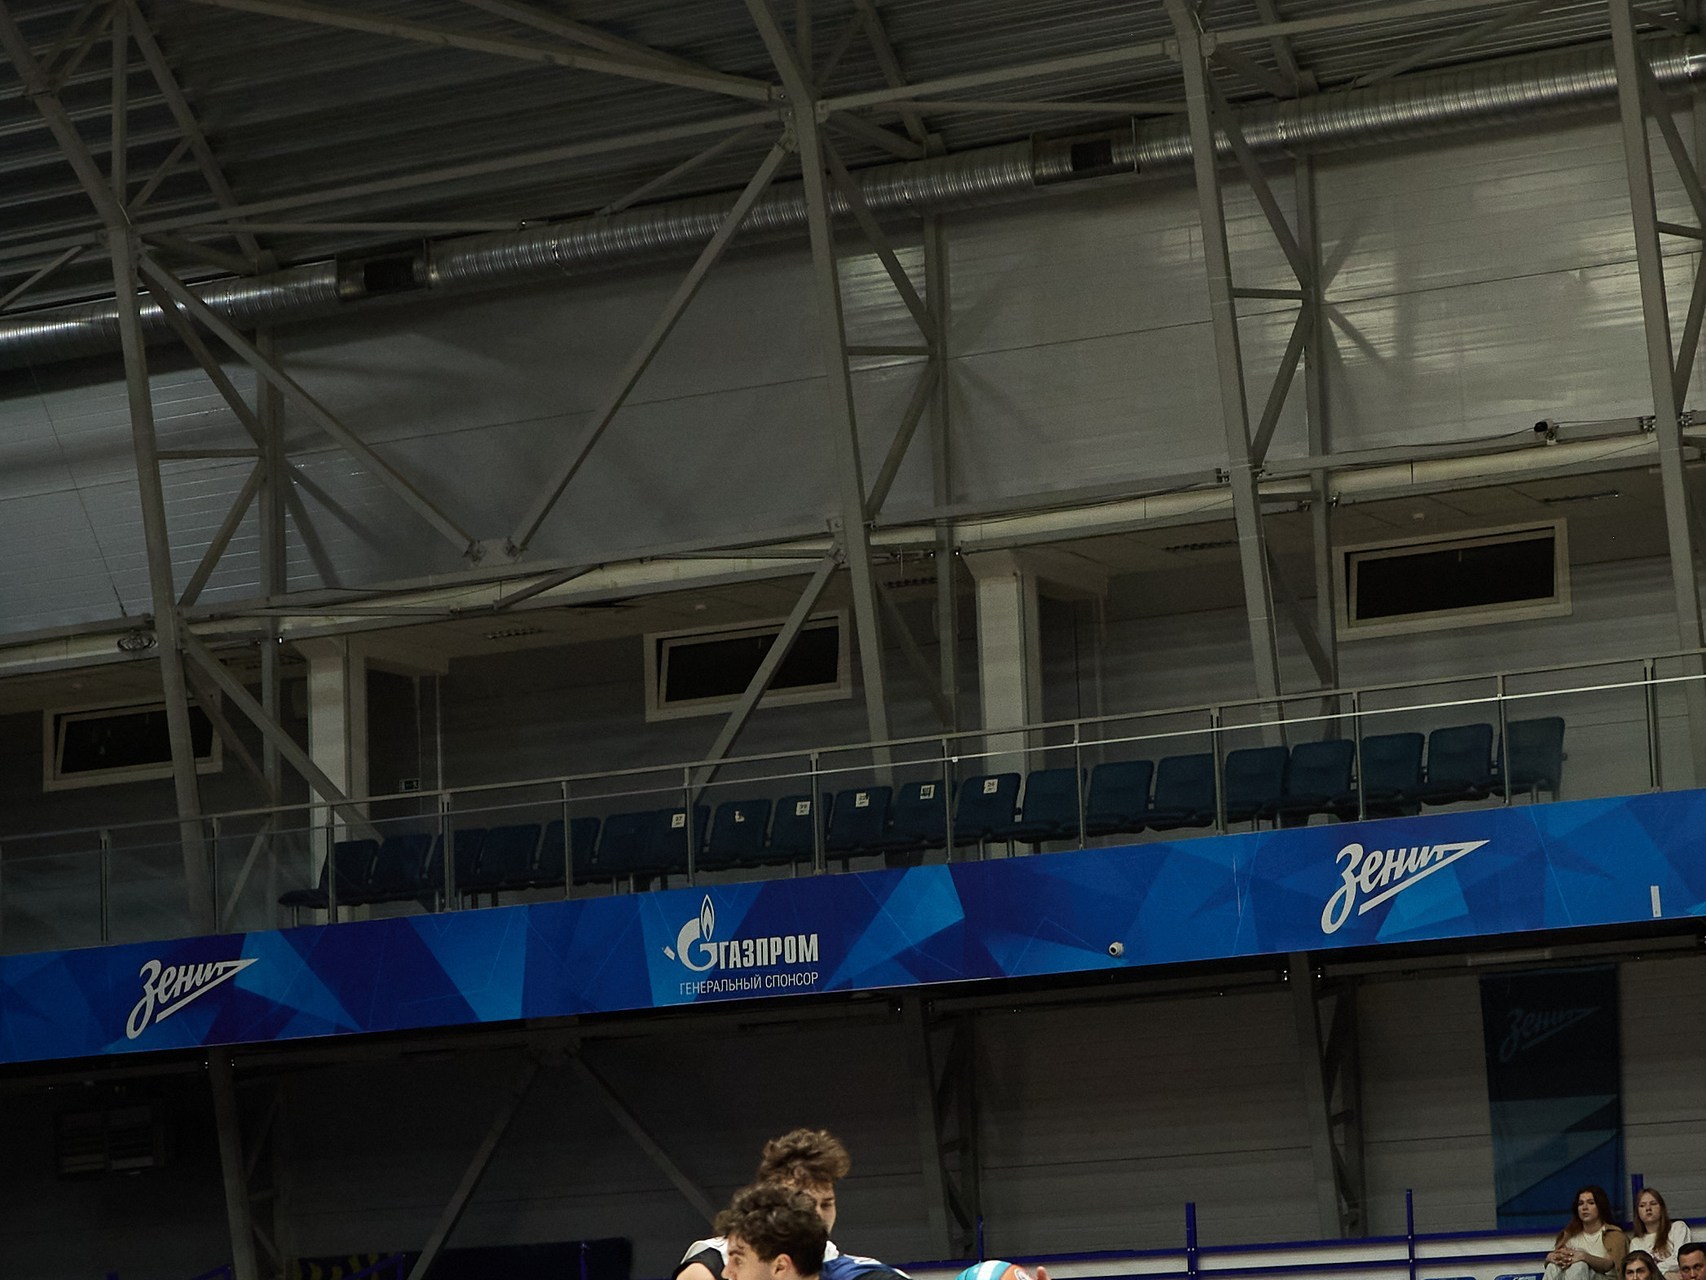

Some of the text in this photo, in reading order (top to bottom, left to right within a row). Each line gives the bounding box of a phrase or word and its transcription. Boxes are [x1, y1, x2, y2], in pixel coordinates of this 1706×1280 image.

[1320, 839, 1490, 935] Зенит
[719, 933, 819, 970] ГАЗПРОМ
[125, 957, 259, 1040] Зенит
[680, 971, 819, 995] ГЕНЕРАЛЬНЫЙ СПОНСОР
